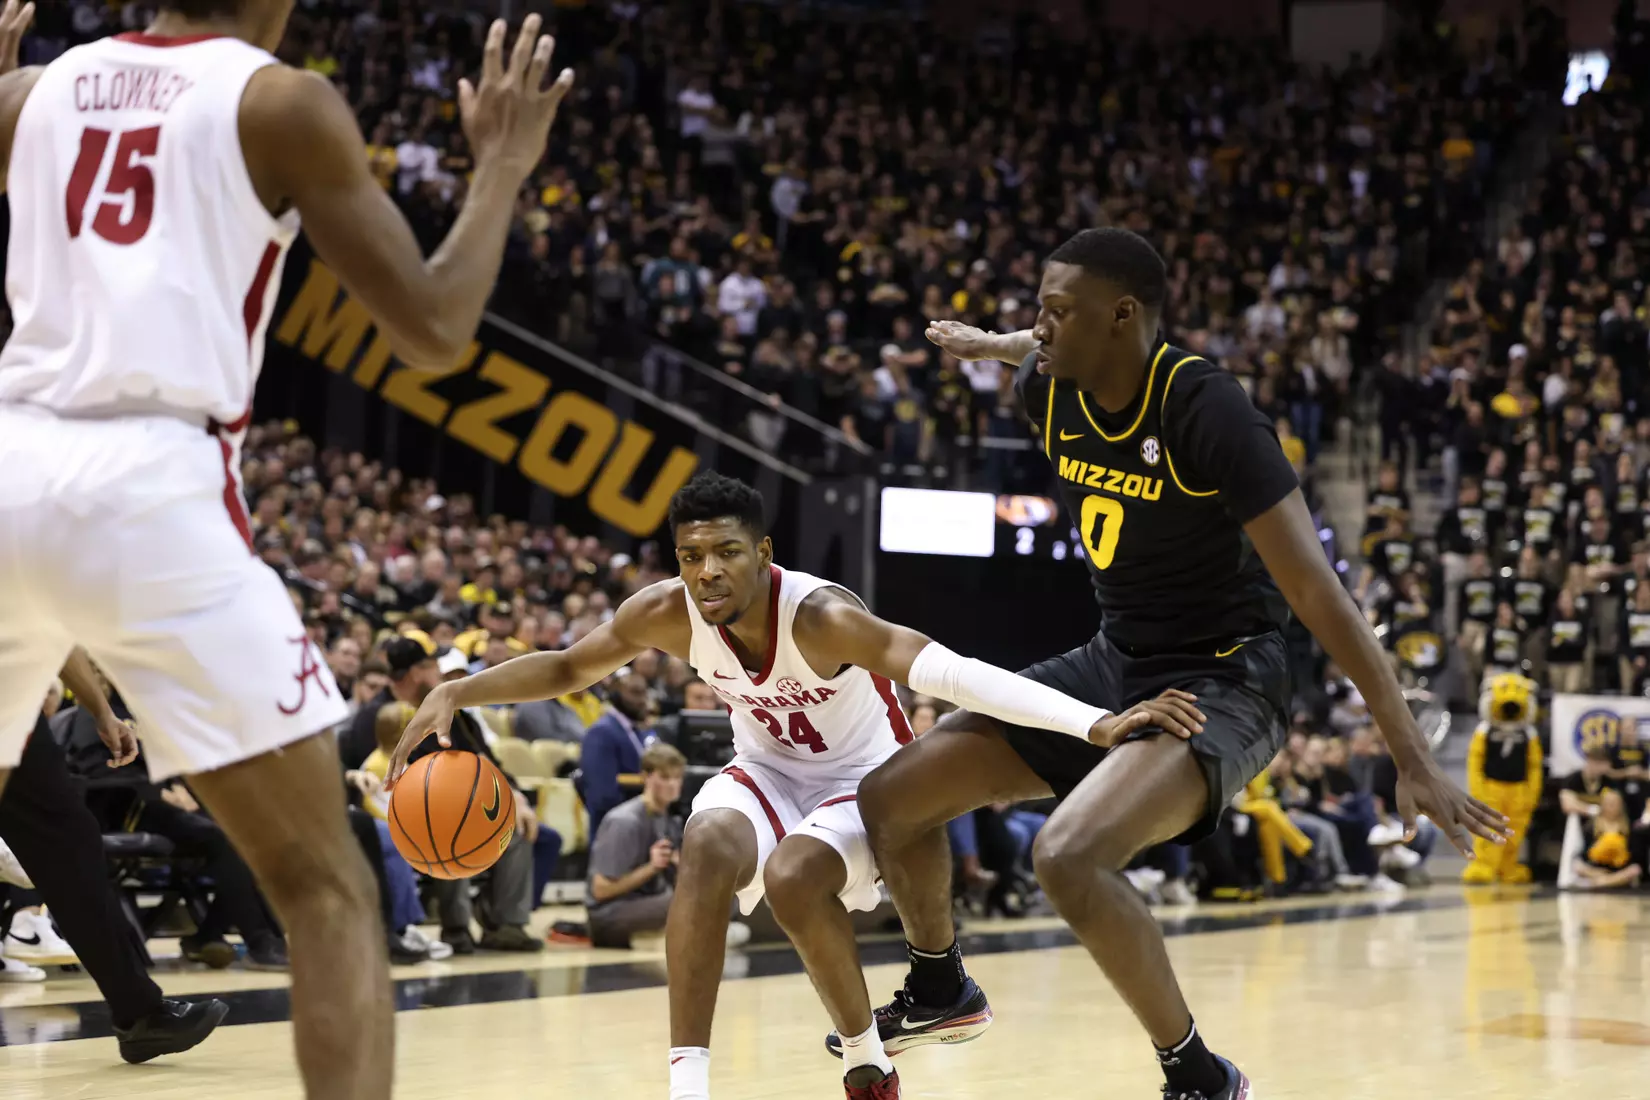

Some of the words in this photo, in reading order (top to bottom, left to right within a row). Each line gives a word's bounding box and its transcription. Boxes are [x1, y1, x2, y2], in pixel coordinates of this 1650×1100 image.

[74, 68, 195, 114] CLOWNEY
[65, 124, 161, 246] 15
[275, 258, 698, 537] MIZZOU
[1058, 455, 1163, 501] MIZZOU
[1081, 494, 1124, 570] 0
[710, 683, 838, 708] ABAMA
[776, 677, 802, 695] SEC
[750, 708, 829, 753] 24
